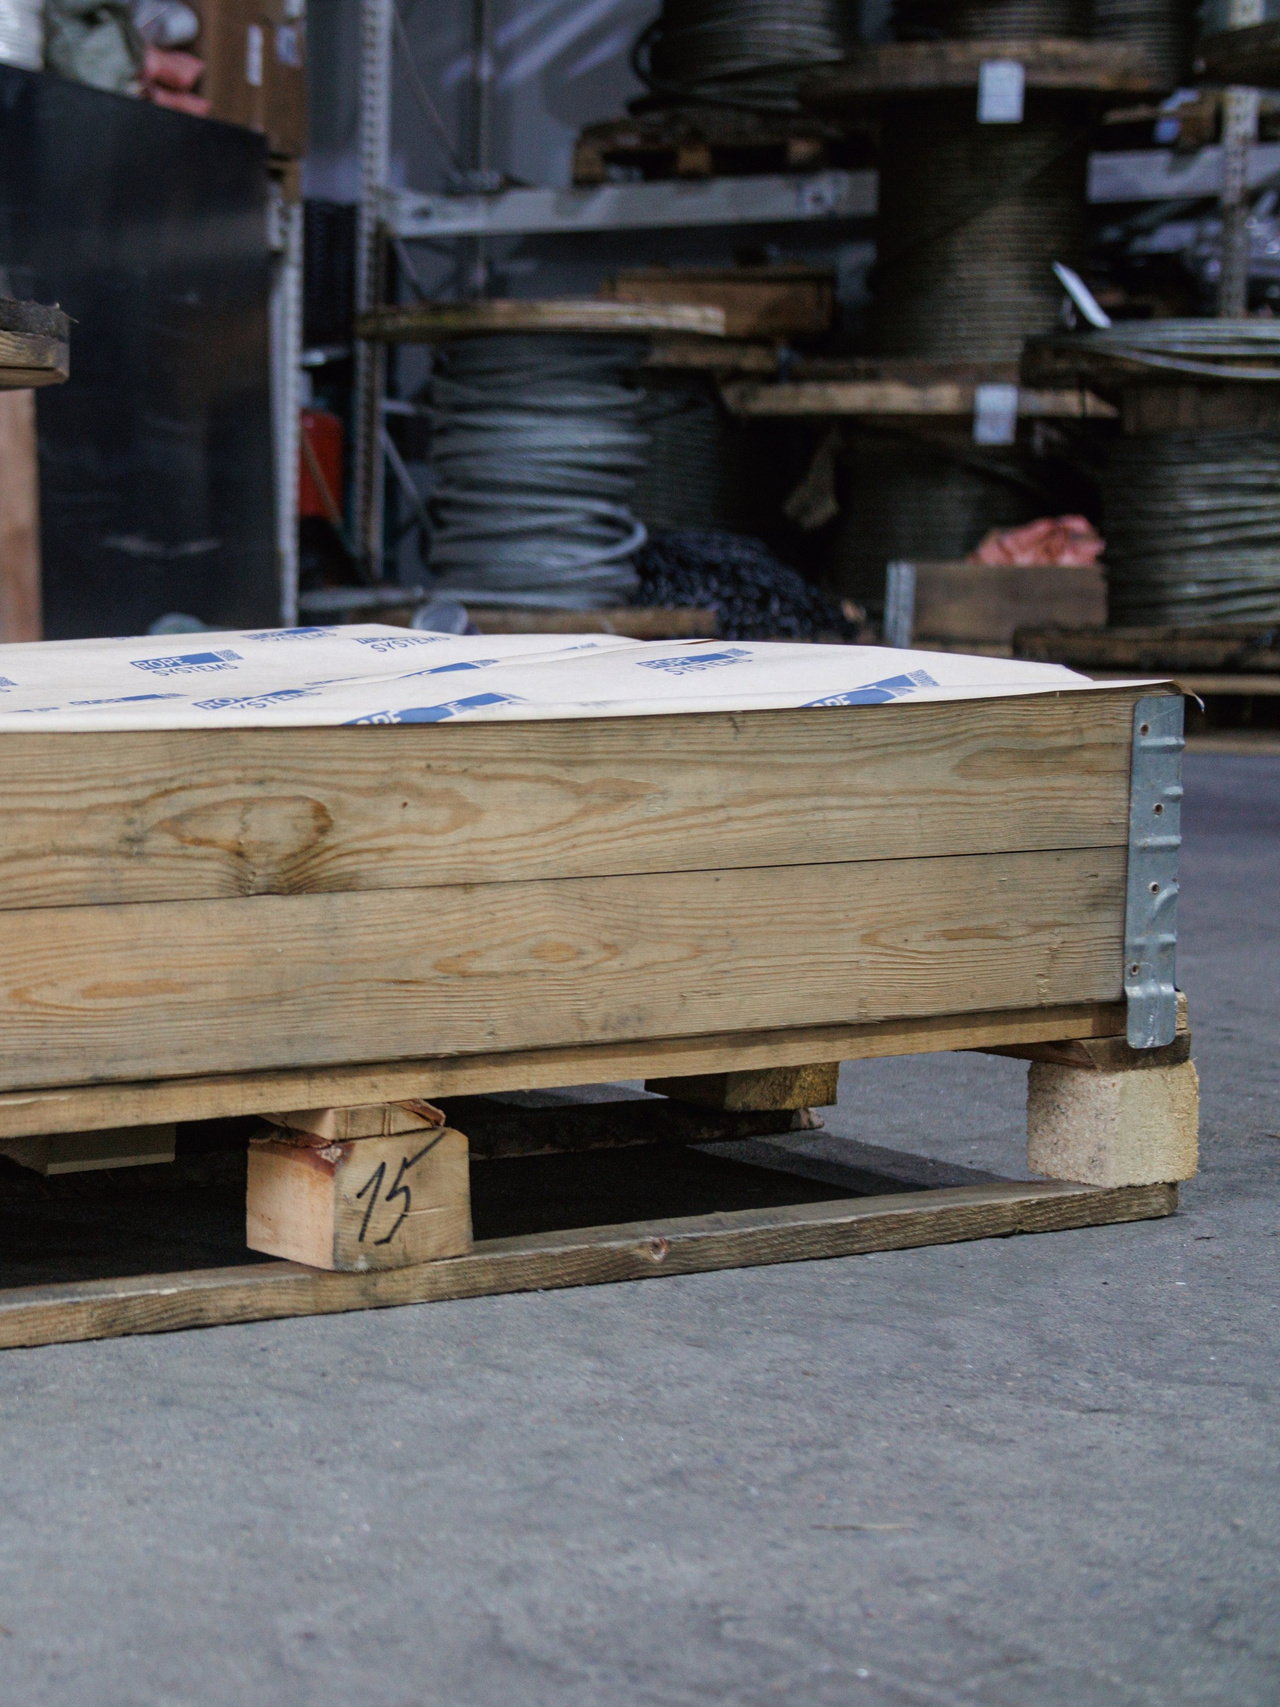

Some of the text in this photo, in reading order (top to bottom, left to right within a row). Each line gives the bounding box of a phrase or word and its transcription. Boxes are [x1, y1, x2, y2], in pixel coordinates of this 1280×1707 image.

[370, 635, 451, 653] SYSTEMS
[136, 656, 194, 670] ROPE
[152, 662, 239, 677] SYSTEMS
[642, 657, 698, 670] ROPE
[664, 658, 753, 676] SYSTEMS
[356, 1130, 447, 1247] 15
